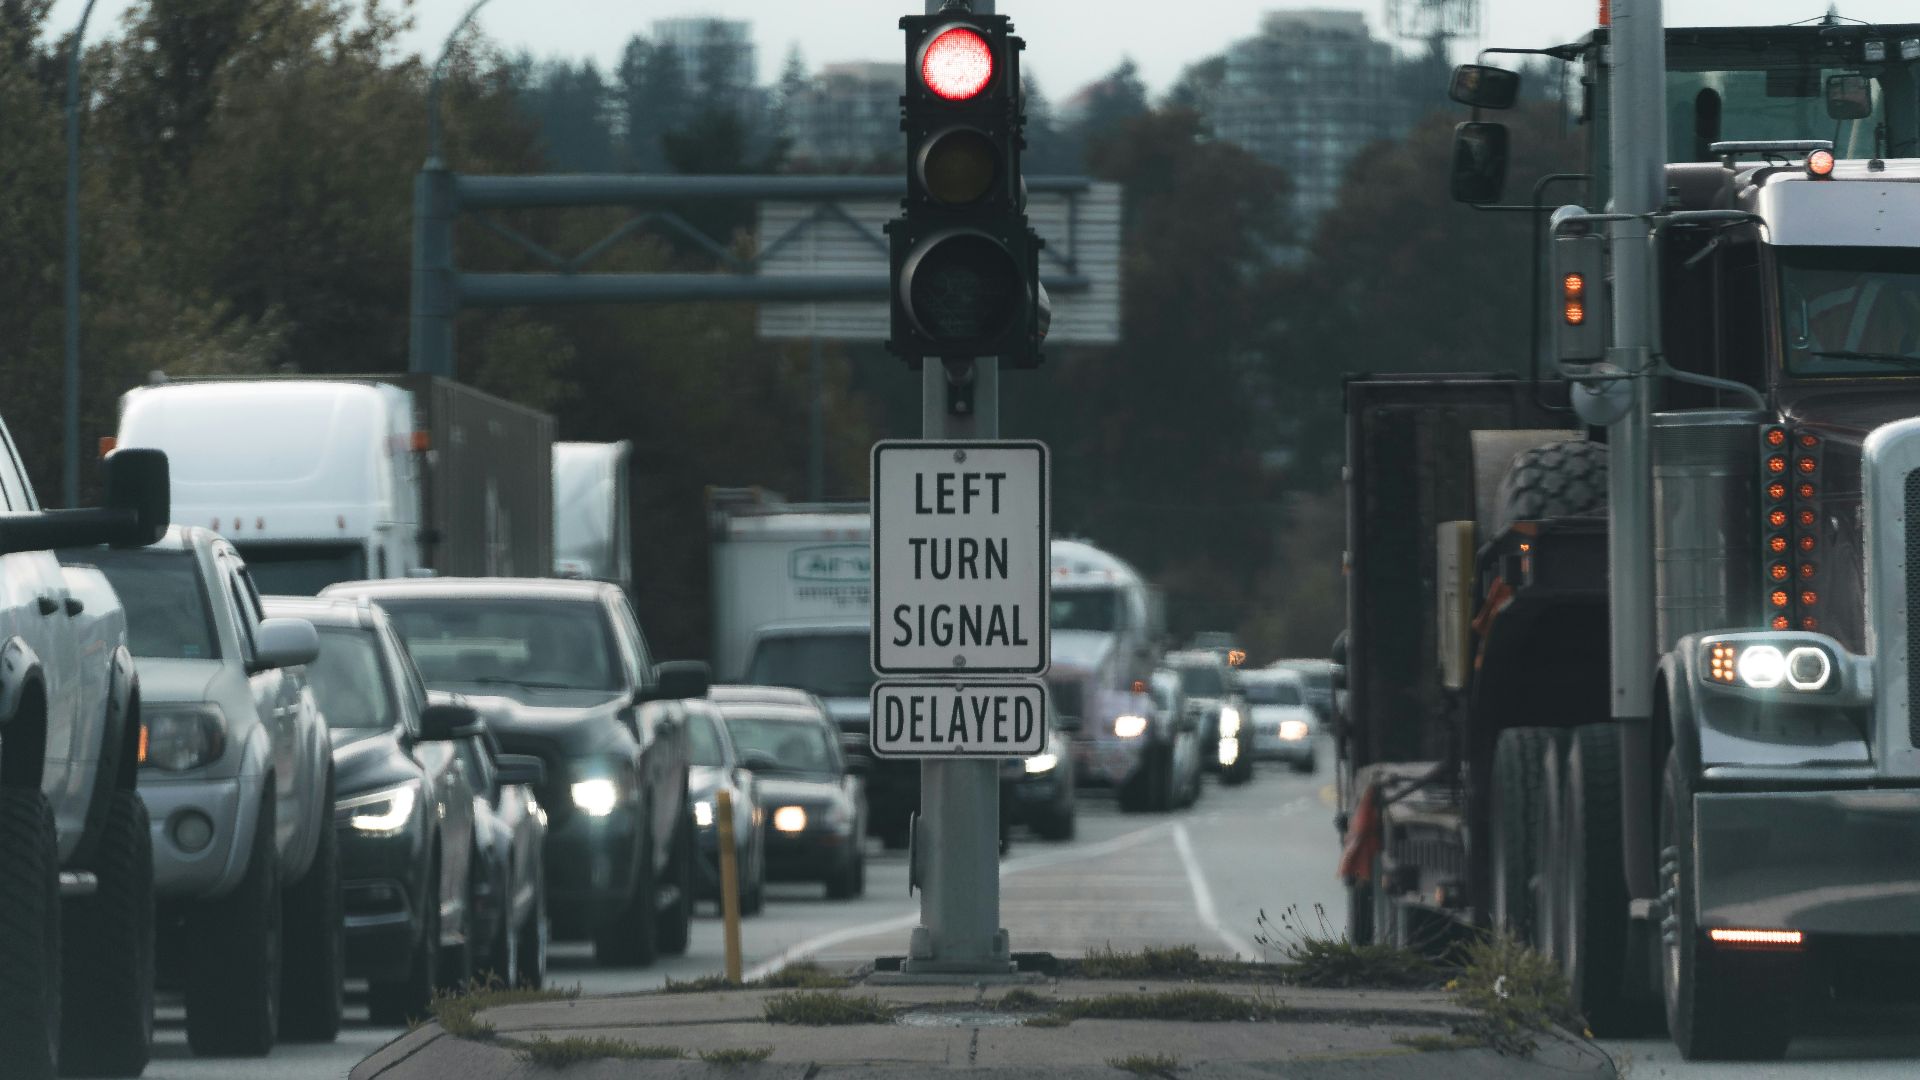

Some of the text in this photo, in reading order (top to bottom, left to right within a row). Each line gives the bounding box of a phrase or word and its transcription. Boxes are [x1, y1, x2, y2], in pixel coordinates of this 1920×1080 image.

[915, 472, 1007, 515] LEFT
[908, 537, 1008, 580] TURN
[892, 604, 1028, 647] SIGNAL
[885, 695, 1034, 743] DELAYED
